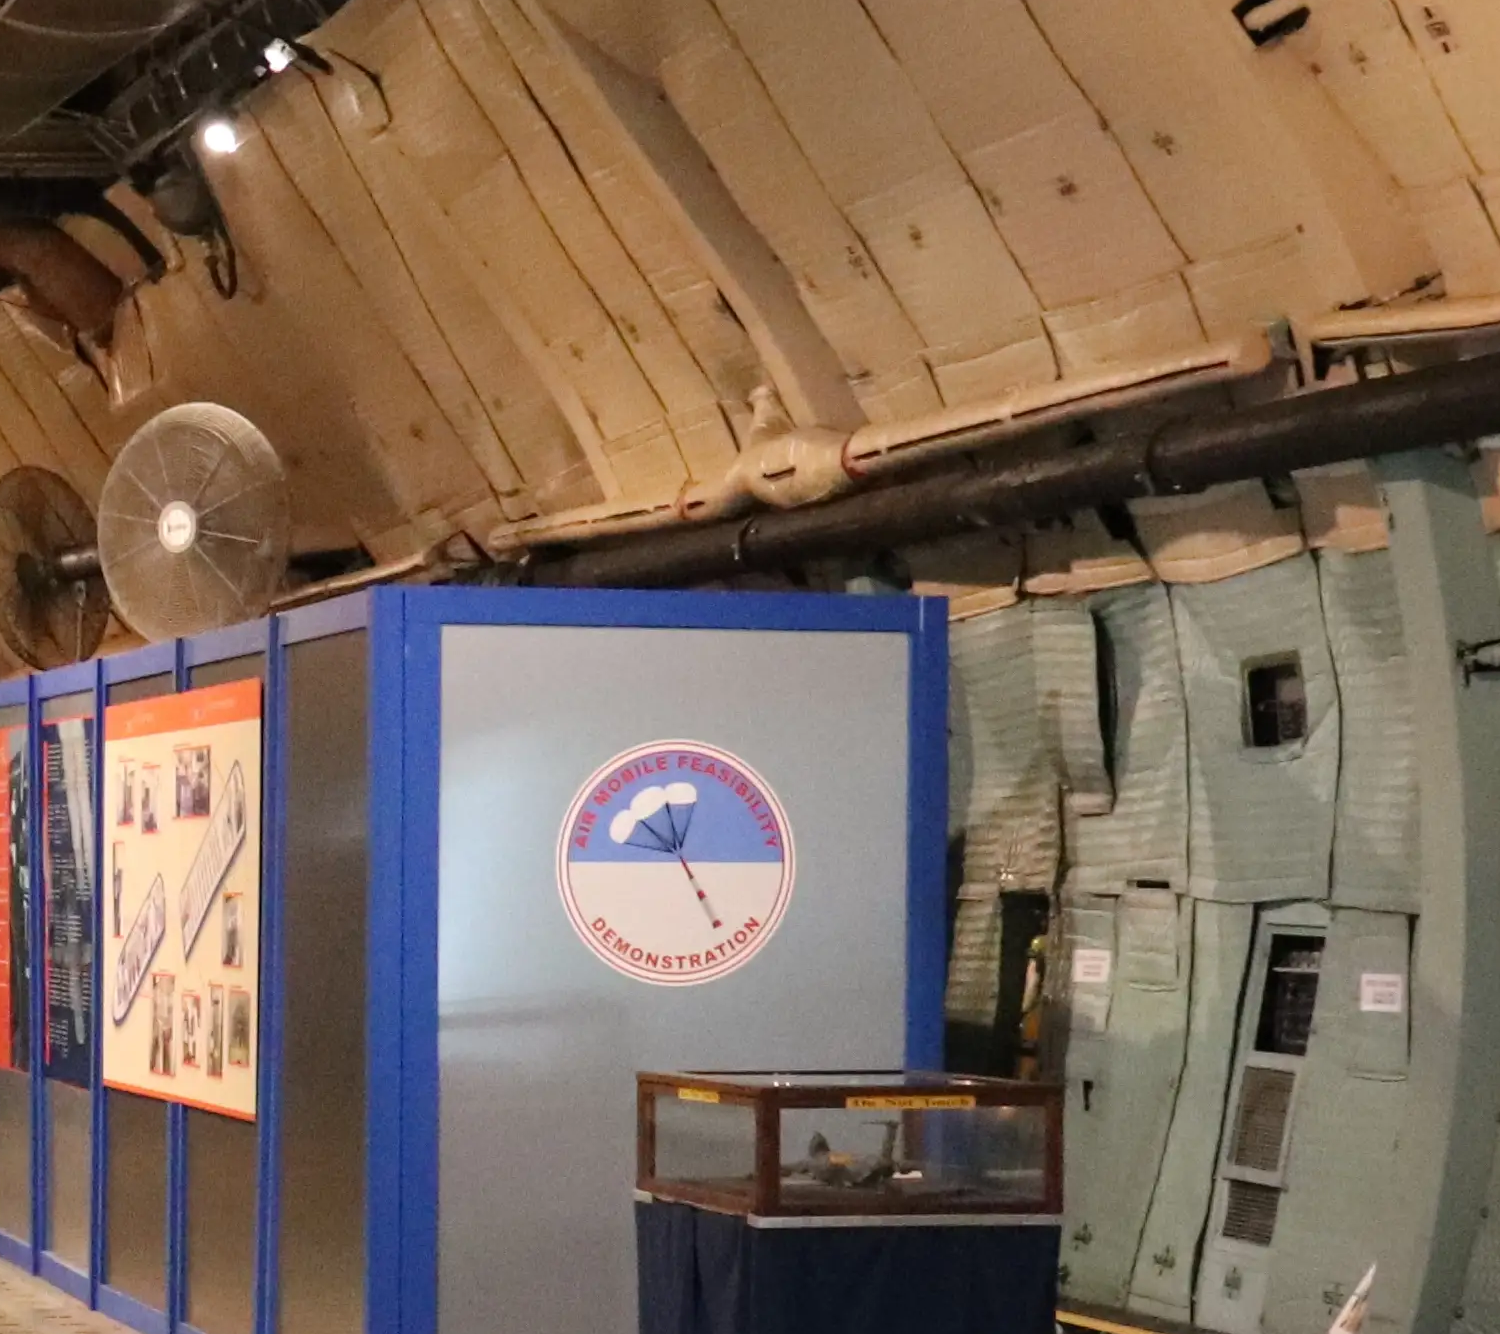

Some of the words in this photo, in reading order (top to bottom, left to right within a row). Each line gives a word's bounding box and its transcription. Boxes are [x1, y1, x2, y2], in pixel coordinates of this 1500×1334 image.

[574, 810, 597, 850] AIR
[593, 754, 669, 808] MOBILE
[677, 754, 782, 849] FEASIBILITY
[590, 915, 762, 970] DEMONSTRATION
